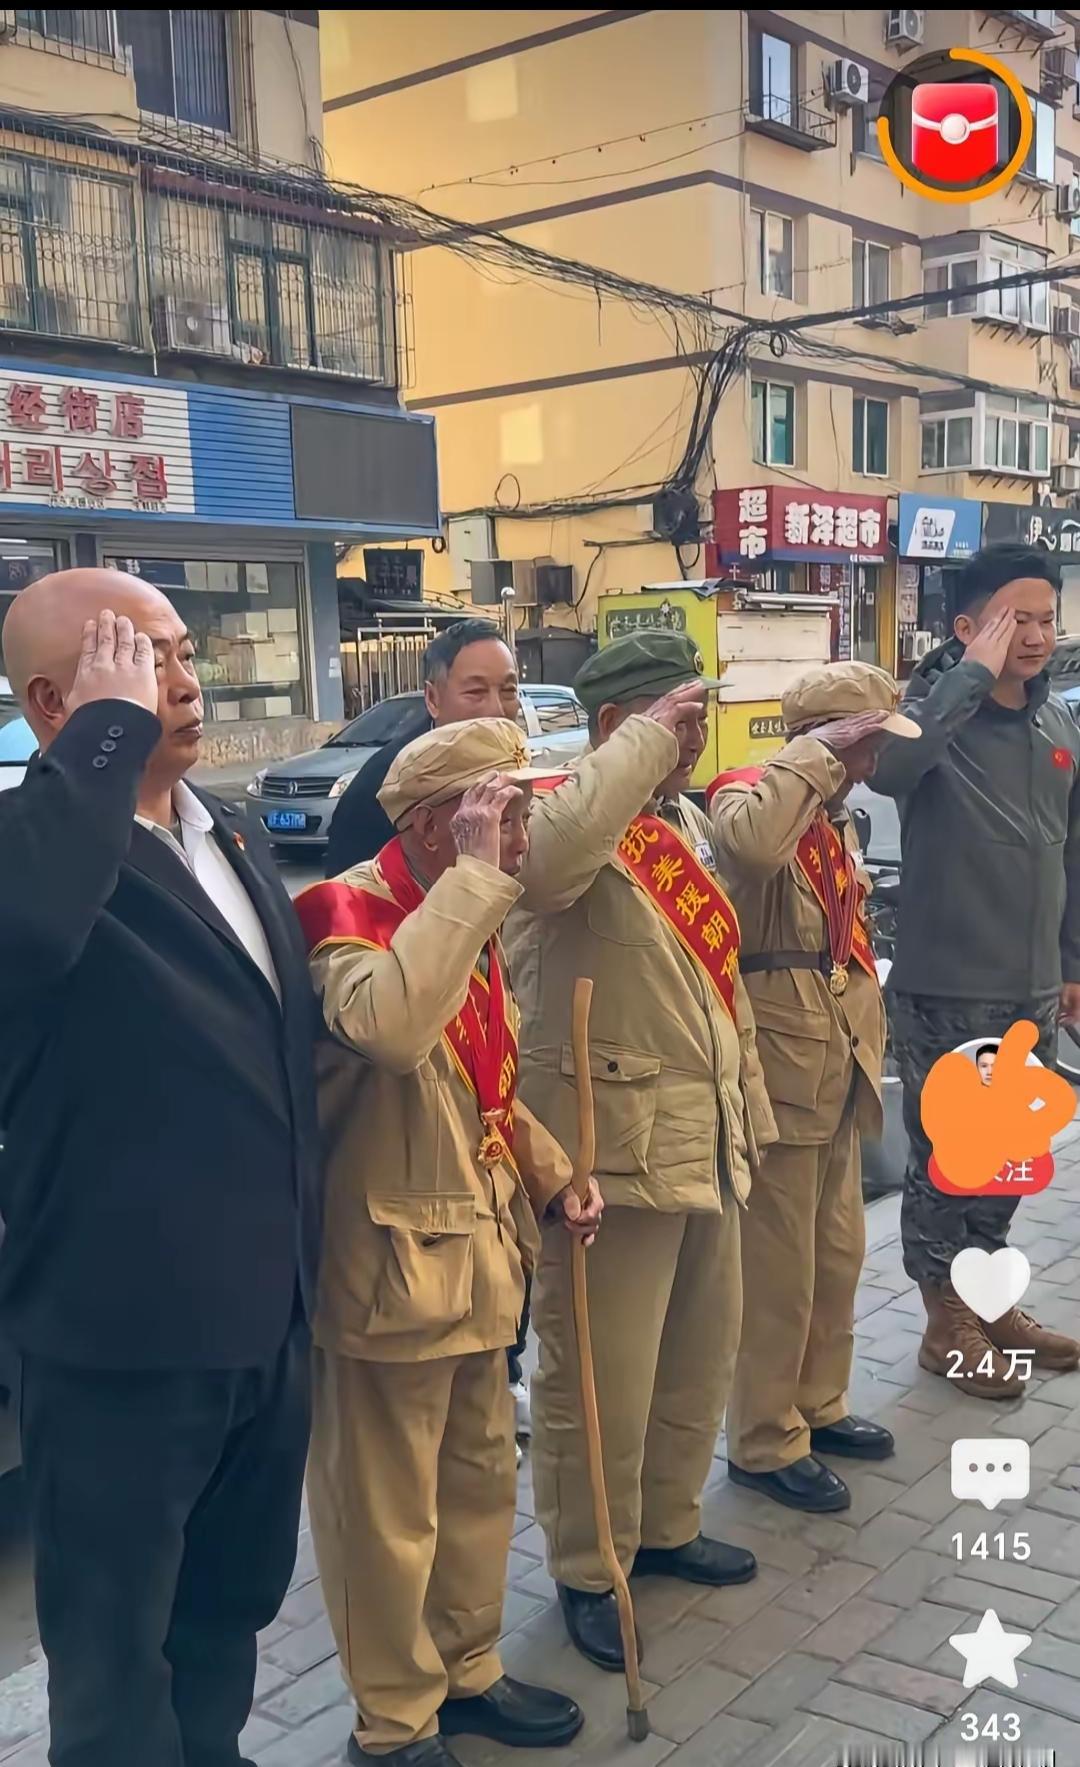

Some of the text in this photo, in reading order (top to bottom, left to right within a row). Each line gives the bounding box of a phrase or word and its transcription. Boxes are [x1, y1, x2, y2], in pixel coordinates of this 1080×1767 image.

[738, 489, 768, 559] 超市
[784, 501, 881, 549] 新泽超市
